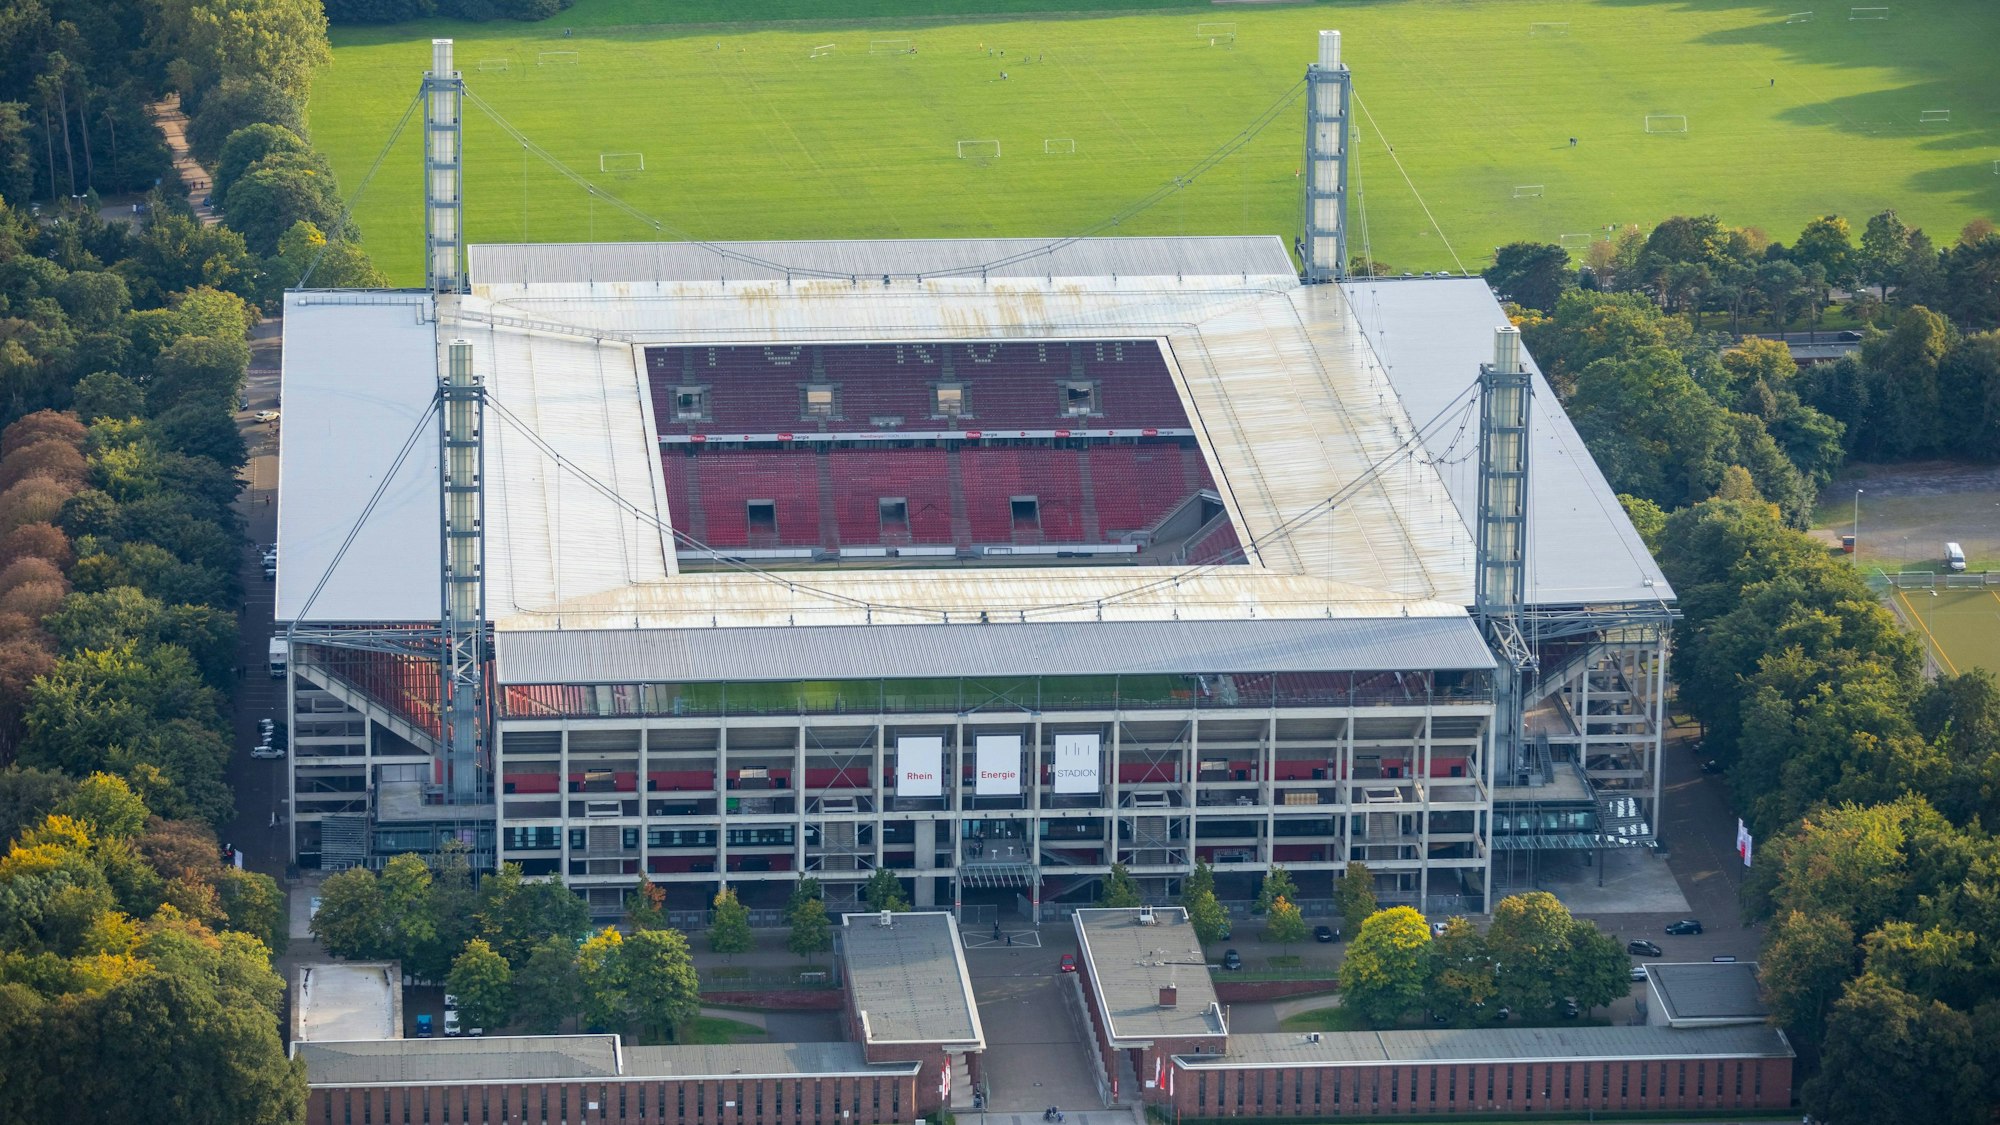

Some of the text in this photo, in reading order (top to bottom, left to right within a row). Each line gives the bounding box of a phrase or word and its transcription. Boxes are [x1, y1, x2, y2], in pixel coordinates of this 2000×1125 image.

[907, 769, 1097, 780] Rhein Energie STADION
